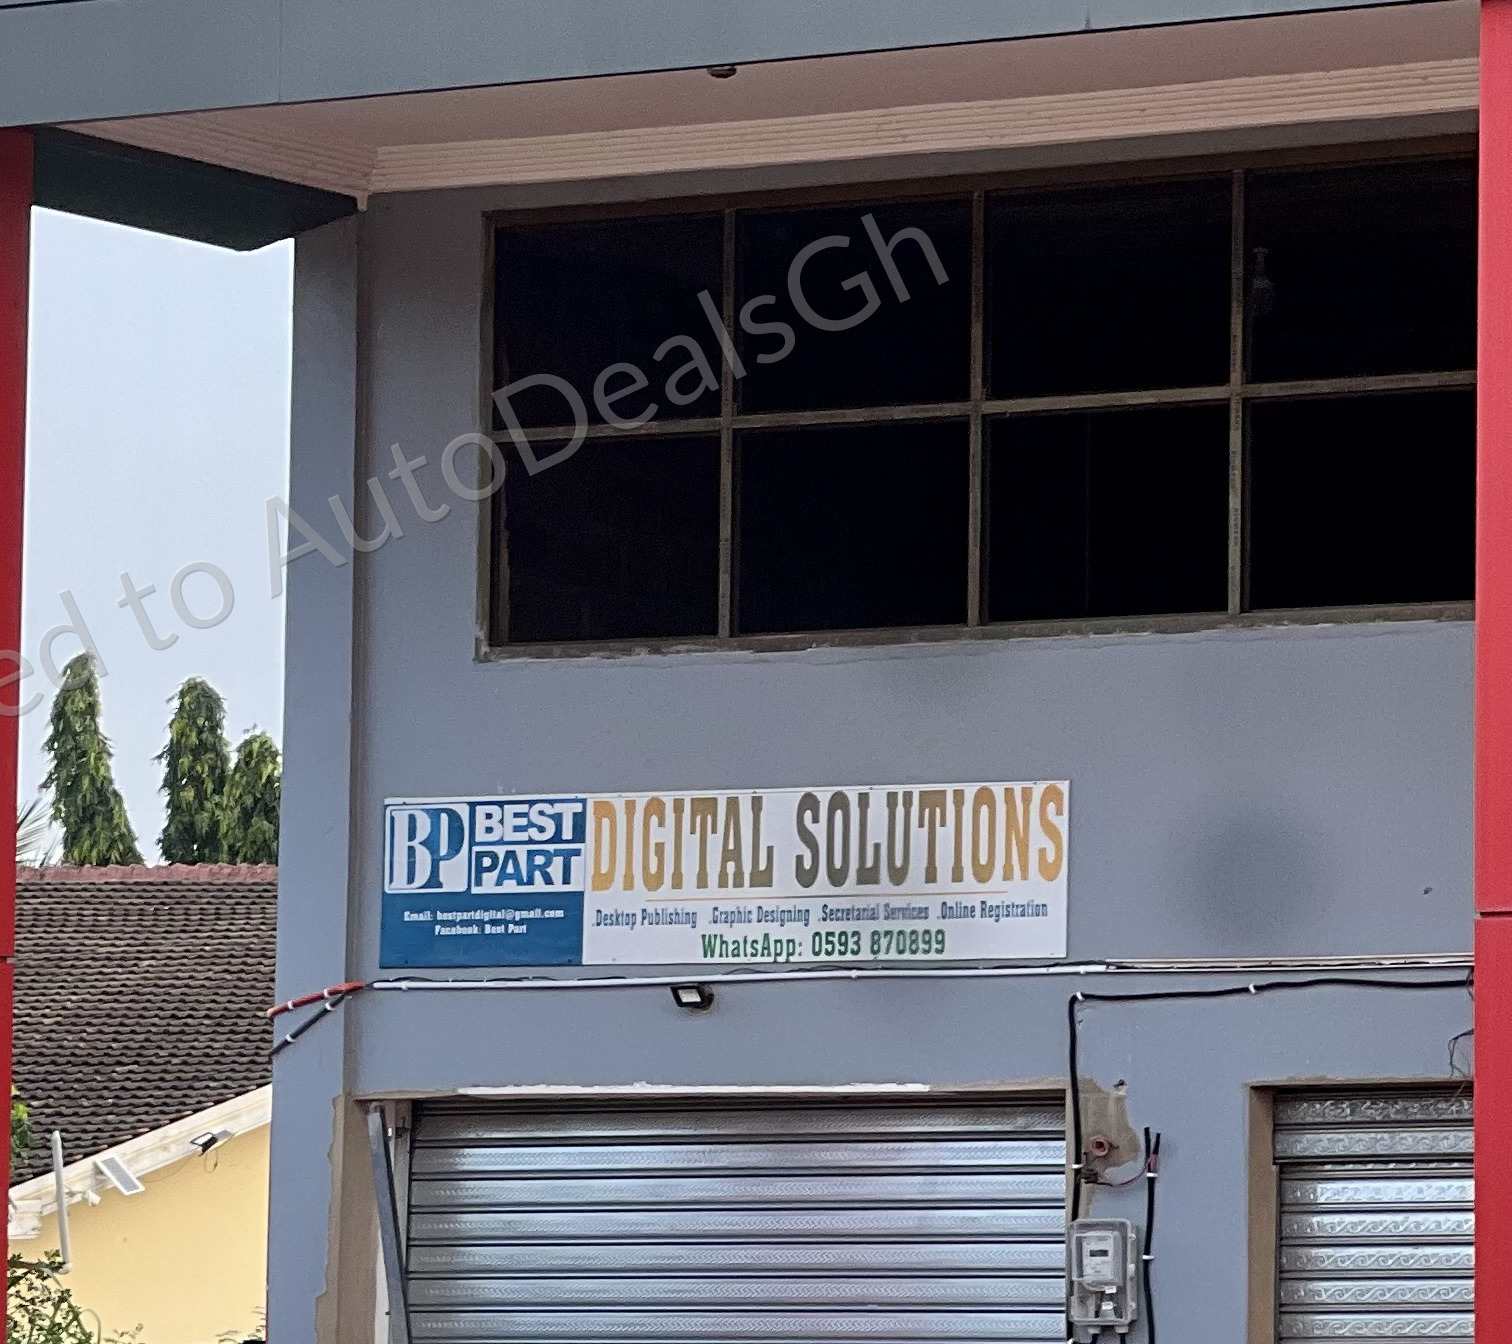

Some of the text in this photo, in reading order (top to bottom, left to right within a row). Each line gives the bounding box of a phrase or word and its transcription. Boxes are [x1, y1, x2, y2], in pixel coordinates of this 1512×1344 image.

[475, 803, 583, 842] BEST
[591, 784, 1064, 892] DIGITAL SOLUTIONS
[474, 849, 582, 887] PART
[640, 908, 698, 928] Publishing
[756, 905, 810, 926] Designing
[883, 902, 930, 920] Services
[980, 899, 1048, 922] Registration
[701, 929, 946, 963] WhatsApp: 0593 870899
